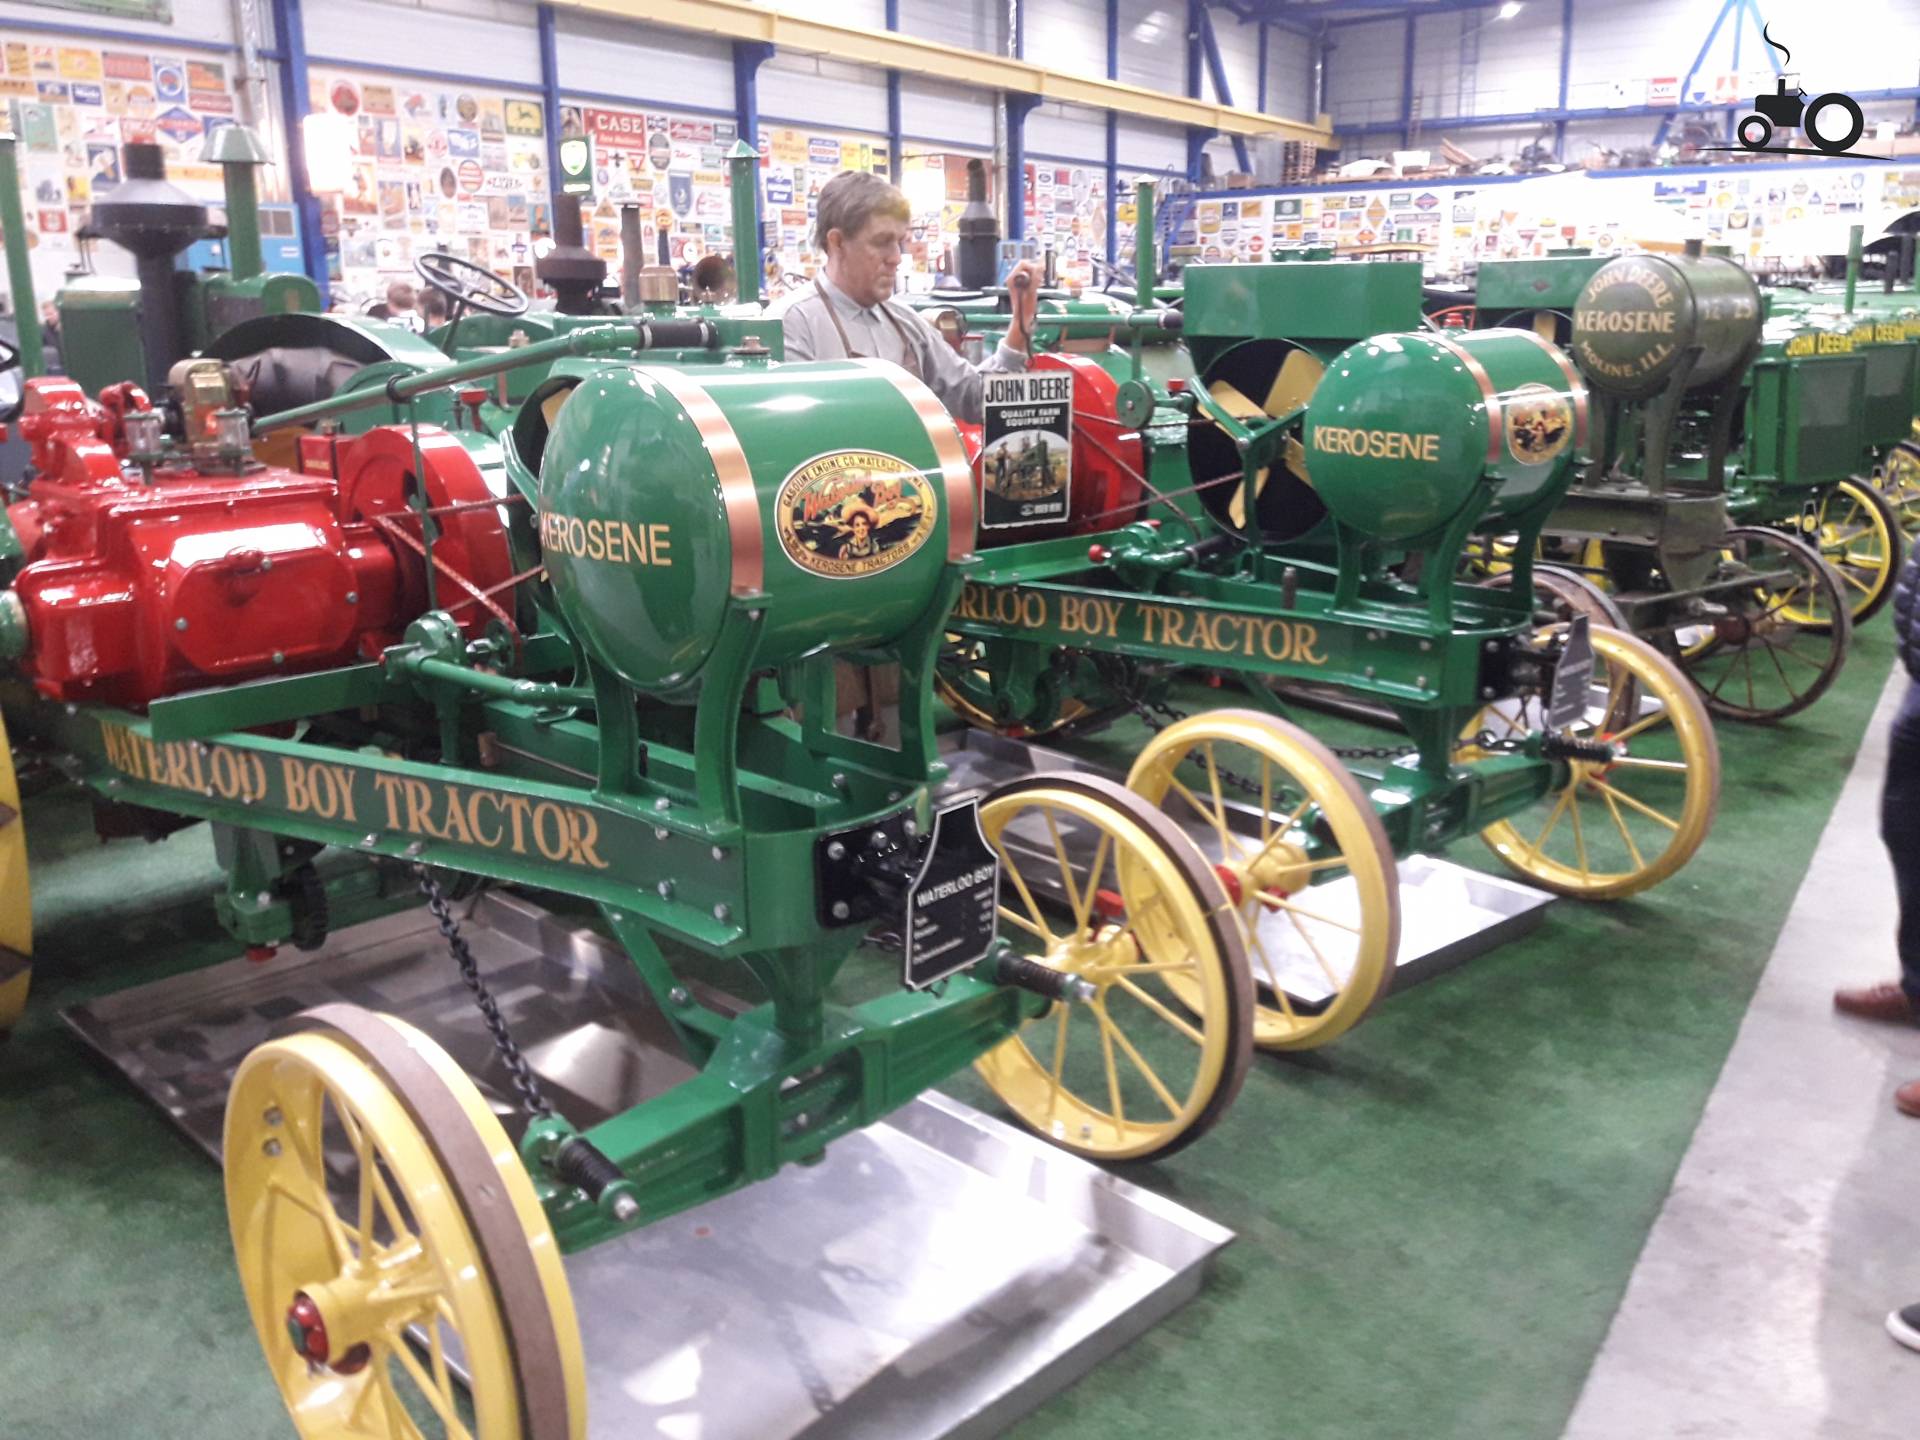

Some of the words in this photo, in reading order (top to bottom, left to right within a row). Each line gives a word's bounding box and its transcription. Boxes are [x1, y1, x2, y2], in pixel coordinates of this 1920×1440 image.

[596, 113, 642, 134] CASE
[1587, 266, 1626, 303] JOHN
[1629, 264, 1675, 308] DEERE
[1576, 310, 1676, 333] KEROSENE
[1786, 334, 1814, 356] JOHN
[1818, 332, 1853, 355] DEERE
[985, 379, 1024, 403] JOHN
[1030, 377, 1071, 400] DEERE
[1000, 408, 1036, 419] QUALITY
[1038, 407, 1061, 416] FARM
[1005, 416, 1056, 427] EQUIPMENT
[1314, 424, 1440, 461] KEROSENE
[783, 470, 813, 508] GASOLINE
[813, 456, 842, 480] ENGINE
[540, 511, 672, 566] KEROSENE
[810, 556, 857, 574] KEROSENE
[863, 543, 911, 572] TRACTORS
[1060, 595, 1125, 637] BOY
[1136, 603, 1328, 665] TRACTOR
[102, 720, 267, 801] WATERLOO
[281, 757, 357, 821] BOY
[375, 772, 609, 868] TRACTOR
[917, 874, 974, 908] WATERLOO
[974, 863, 996, 886] BOY
